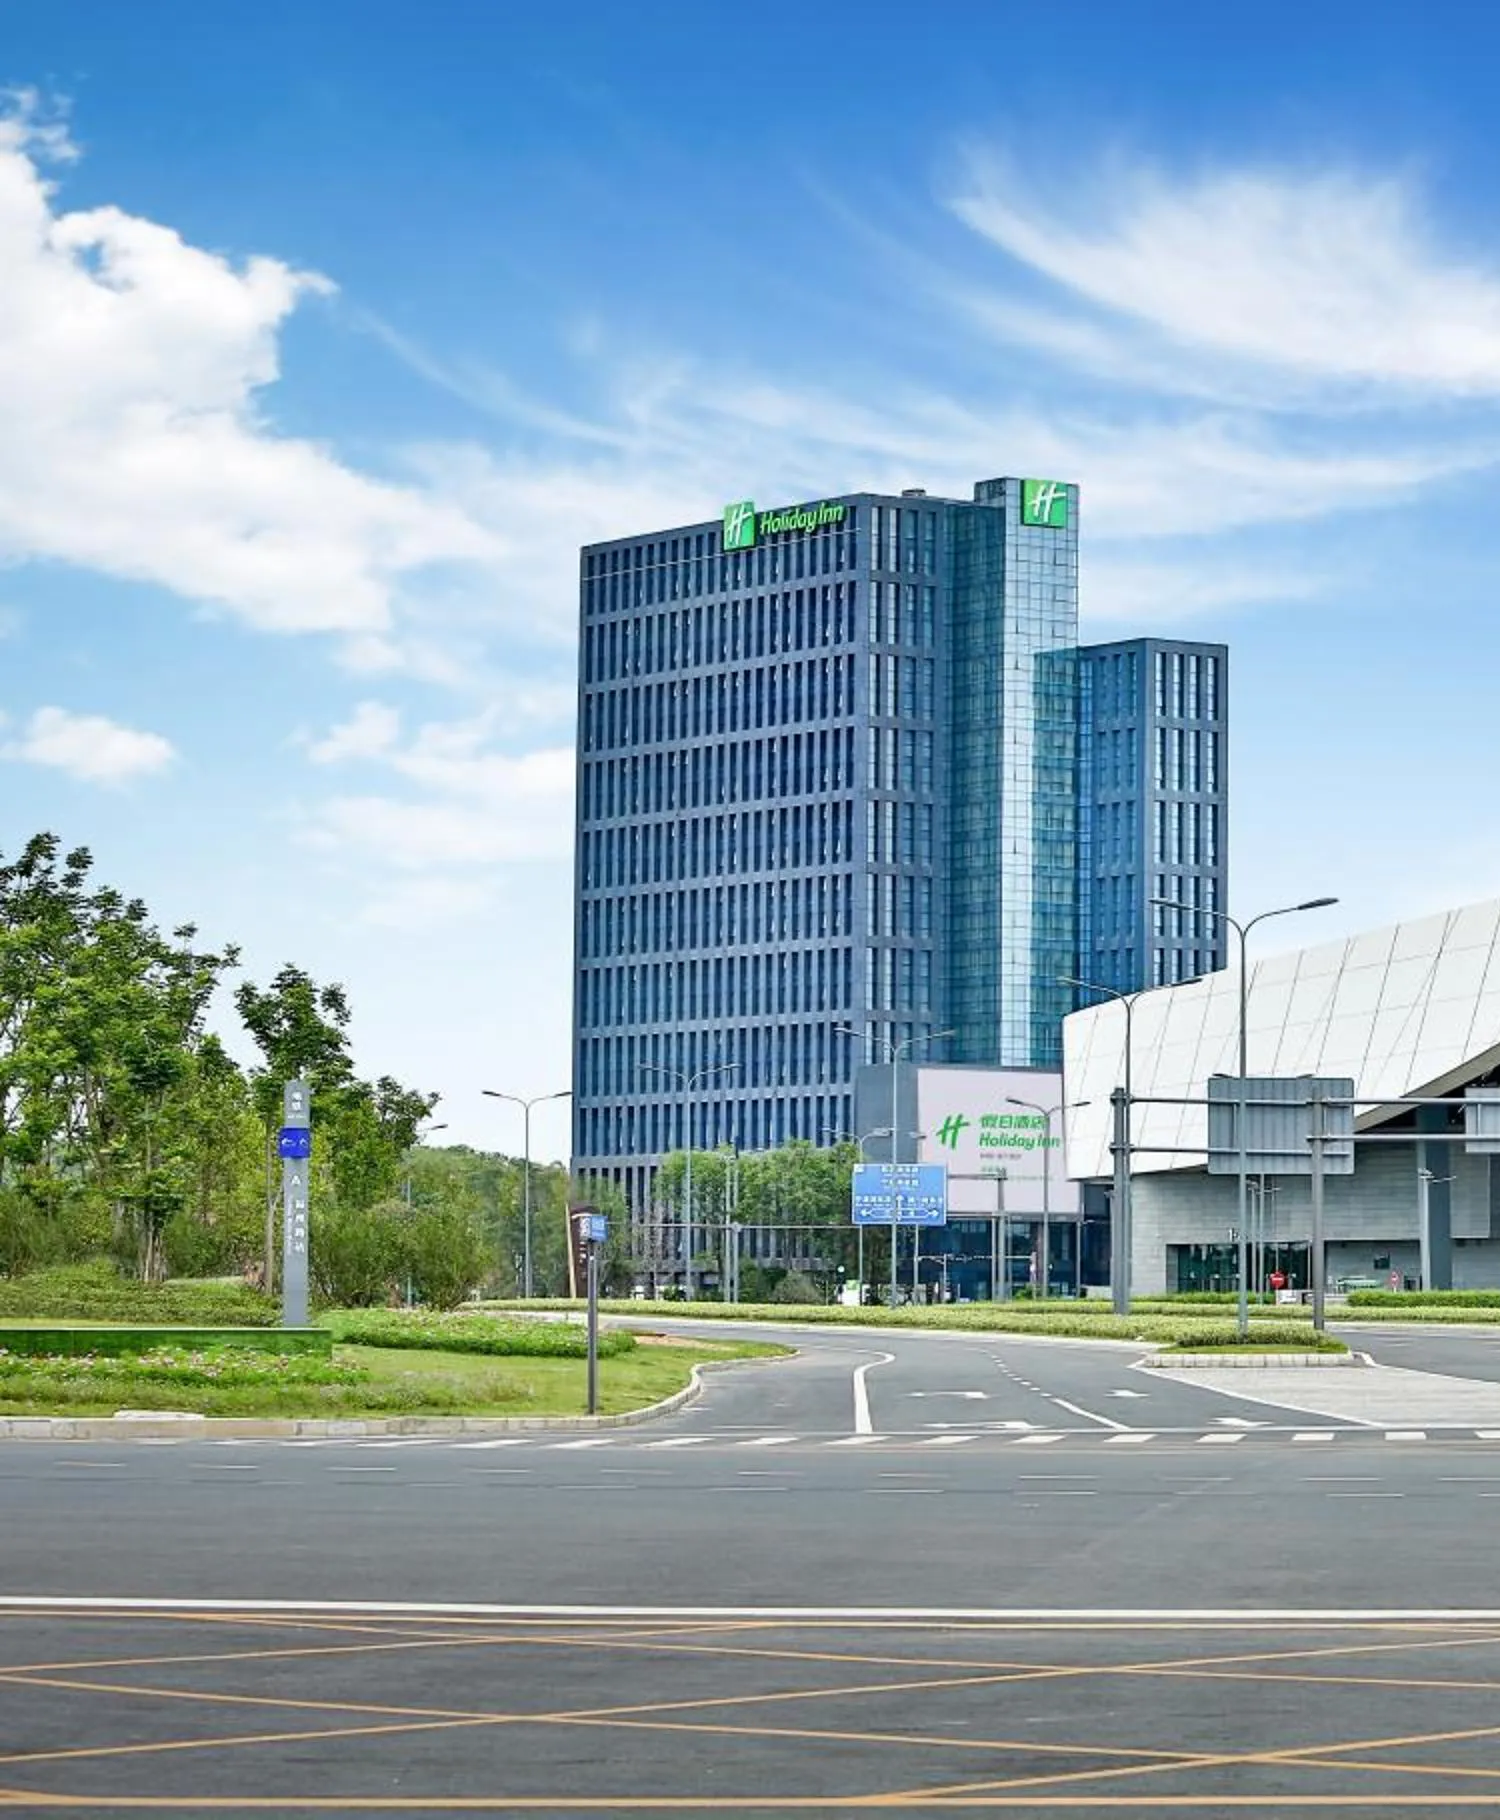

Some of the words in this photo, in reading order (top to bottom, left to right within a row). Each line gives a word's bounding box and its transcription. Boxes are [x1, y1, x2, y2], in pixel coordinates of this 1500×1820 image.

[760, 508, 817, 535] Holiday
[818, 501, 845, 525] Inn
[979, 1132, 1036, 1151] Holiday
